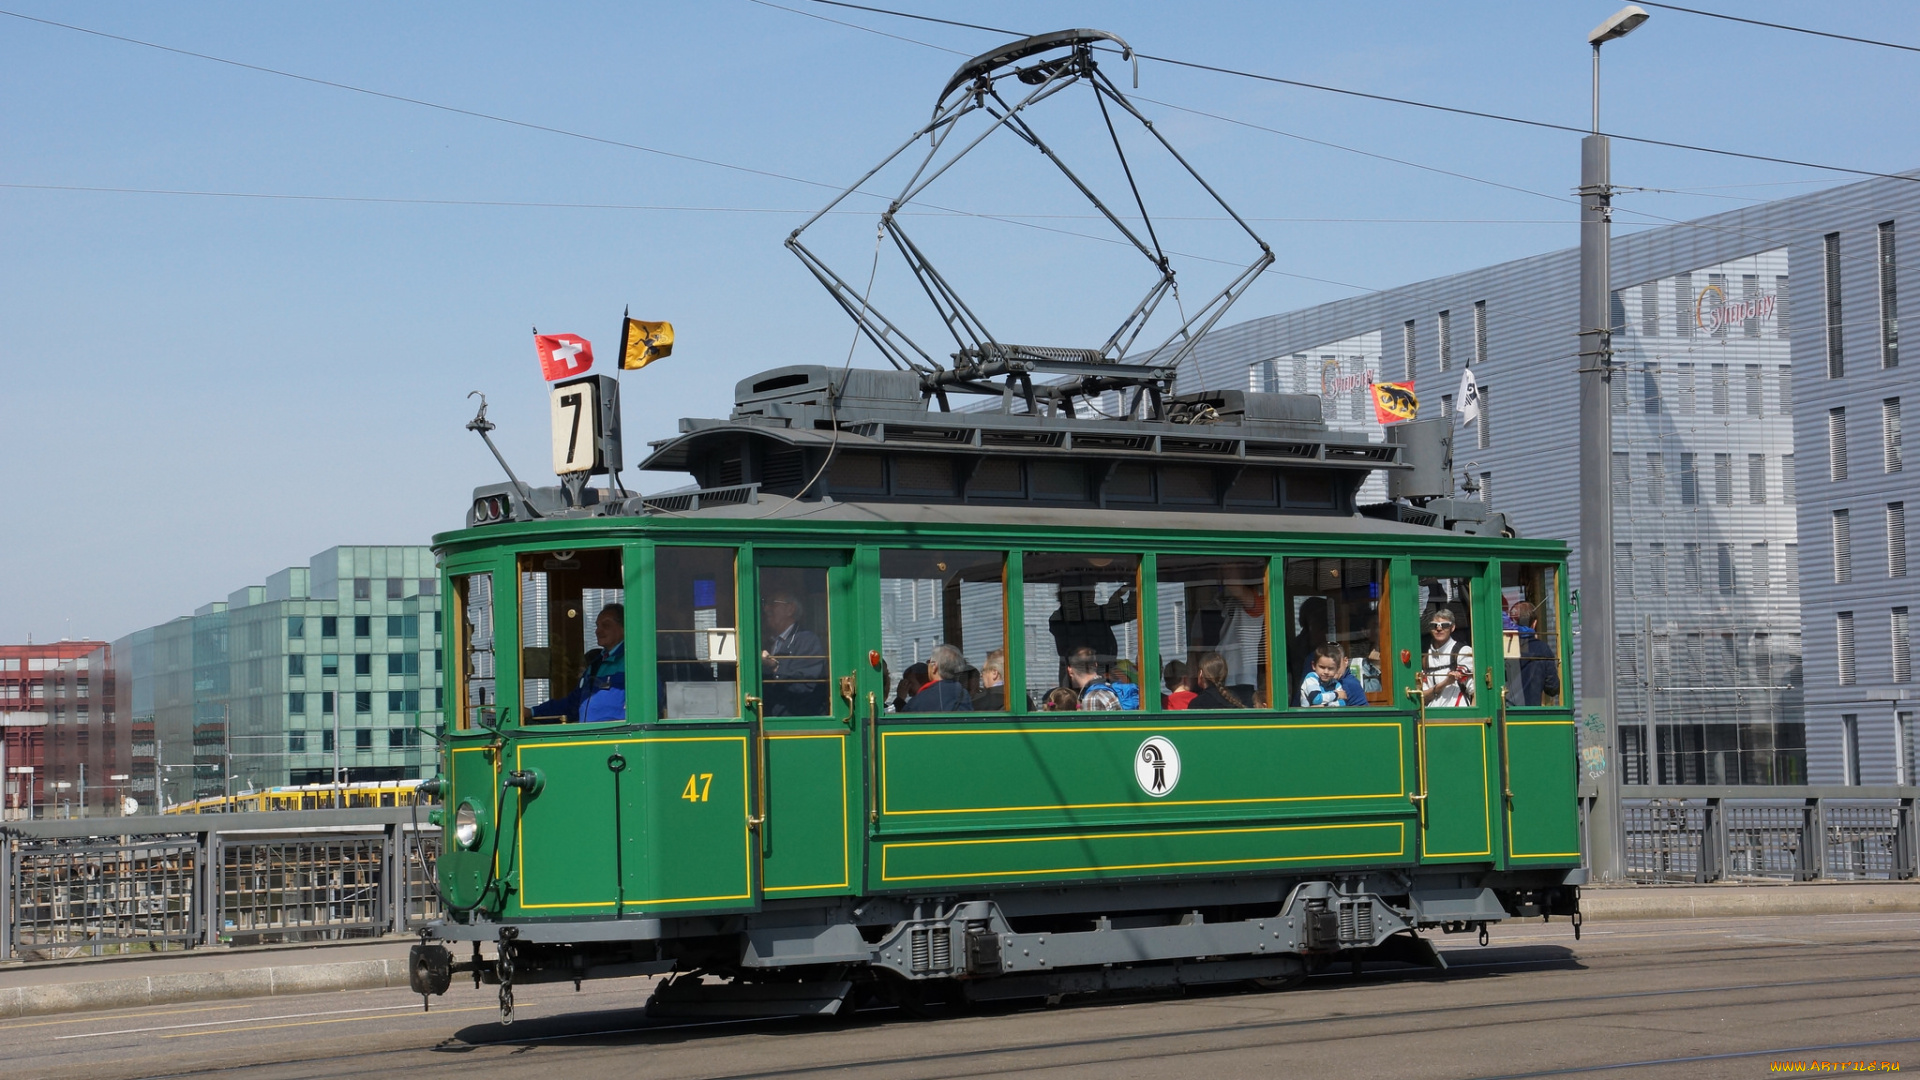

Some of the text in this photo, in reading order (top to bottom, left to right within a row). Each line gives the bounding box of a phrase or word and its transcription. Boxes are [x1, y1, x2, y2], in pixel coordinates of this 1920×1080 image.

[1708, 294, 1776, 334] sympany
[560, 392, 582, 464] 7
[716, 631, 727, 655] 7
[681, 773, 713, 802] 47
